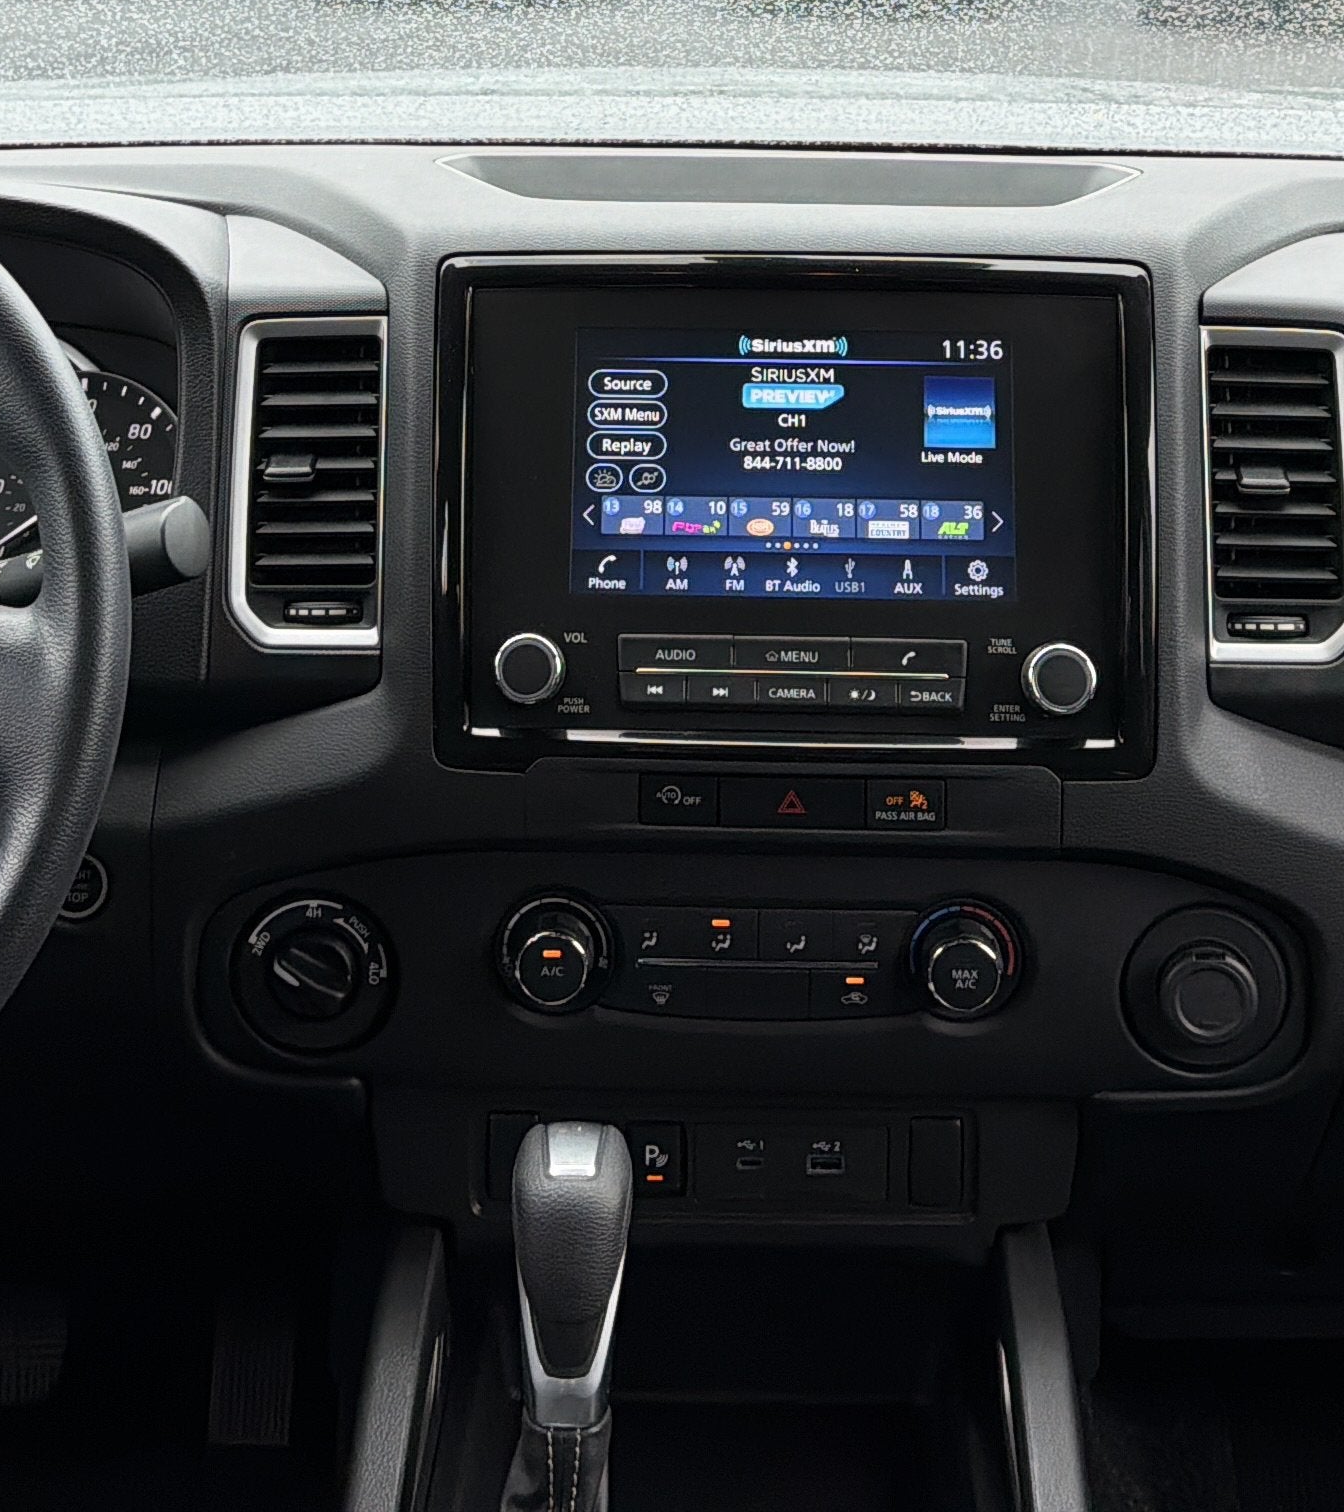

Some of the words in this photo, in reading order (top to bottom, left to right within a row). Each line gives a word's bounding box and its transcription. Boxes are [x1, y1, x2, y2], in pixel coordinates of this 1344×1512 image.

[942, 339, 1004, 360] 11:36
[603, 376, 653, 391] Source
[750, 388, 836, 404] PREVIEW
[594, 407, 622, 421] SXM
[625, 408, 660, 422] Menu
[777, 414, 806, 427] CH1
[127, 423, 152, 440] 80
[601, 438, 652, 455] Replay
[729, 438, 771, 452] Great
[774, 438, 814, 452] Offer
[817, 439, 856, 453] Now!
[743, 455, 843, 471] 844-711-8800
[921, 451, 945, 463] Live
[947, 451, 983, 464] Mode
[122, 459, 138, 470] 140
[129, 486, 145, 495] 160
[12, 503, 26, 513] 20
[605, 501, 619, 513] 13
[643, 500, 663, 514] 98
[669, 501, 684, 514] 14
[708, 501, 727, 515] 10
[732, 502, 748, 514] 15
[771, 502, 790, 516] 59
[796, 503, 812, 516] 16
[836, 503, 855, 517] 18
[861, 504, 876, 516] 17
[899, 503, 919, 518] 58
[925, 504, 940, 517] 18
[963, 505, 983, 519] 36
[588, 577, 627, 590] Phone
[665, 578, 689, 590] AM
[725, 579, 745, 591] FM
[765, 580, 781, 591] BT
[783, 580, 821, 592] Audio
[834, 581, 865, 593] USB1
[894, 583, 923, 594] AUX
[954, 583, 1005, 598] Settings
[563, 632, 588, 644] VOL
[990, 638, 1013, 646] TUNE
[655, 649, 697, 661] AUDIO
[987, 646, 1018, 655] SCROLL
[780, 651, 819, 663] MENU
[768, 687, 816, 699] CAMERA
[922, 691, 953, 702] BACK
[563, 697, 584, 705] PUSH
[557, 704, 590, 714] POWER
[993, 704, 1021, 713] ENTER
[989, 713, 1026, 722] SETTING
[682, 796, 702, 806] OFF
[885, 796, 904, 806] OFF
[874, 811, 899, 821] PASS
[900, 811, 915, 821] AIR
[917, 812, 936, 821] BAG
[305, 907, 322, 919] 4H
[348, 915, 371, 939] PUSH
[251, 931, 271, 957] 2WD
[368, 961, 380, 986] 4LO
[540, 966, 566, 977] A/C
[951, 969, 979, 980] MAX
[955, 979, 977, 990] A/C
